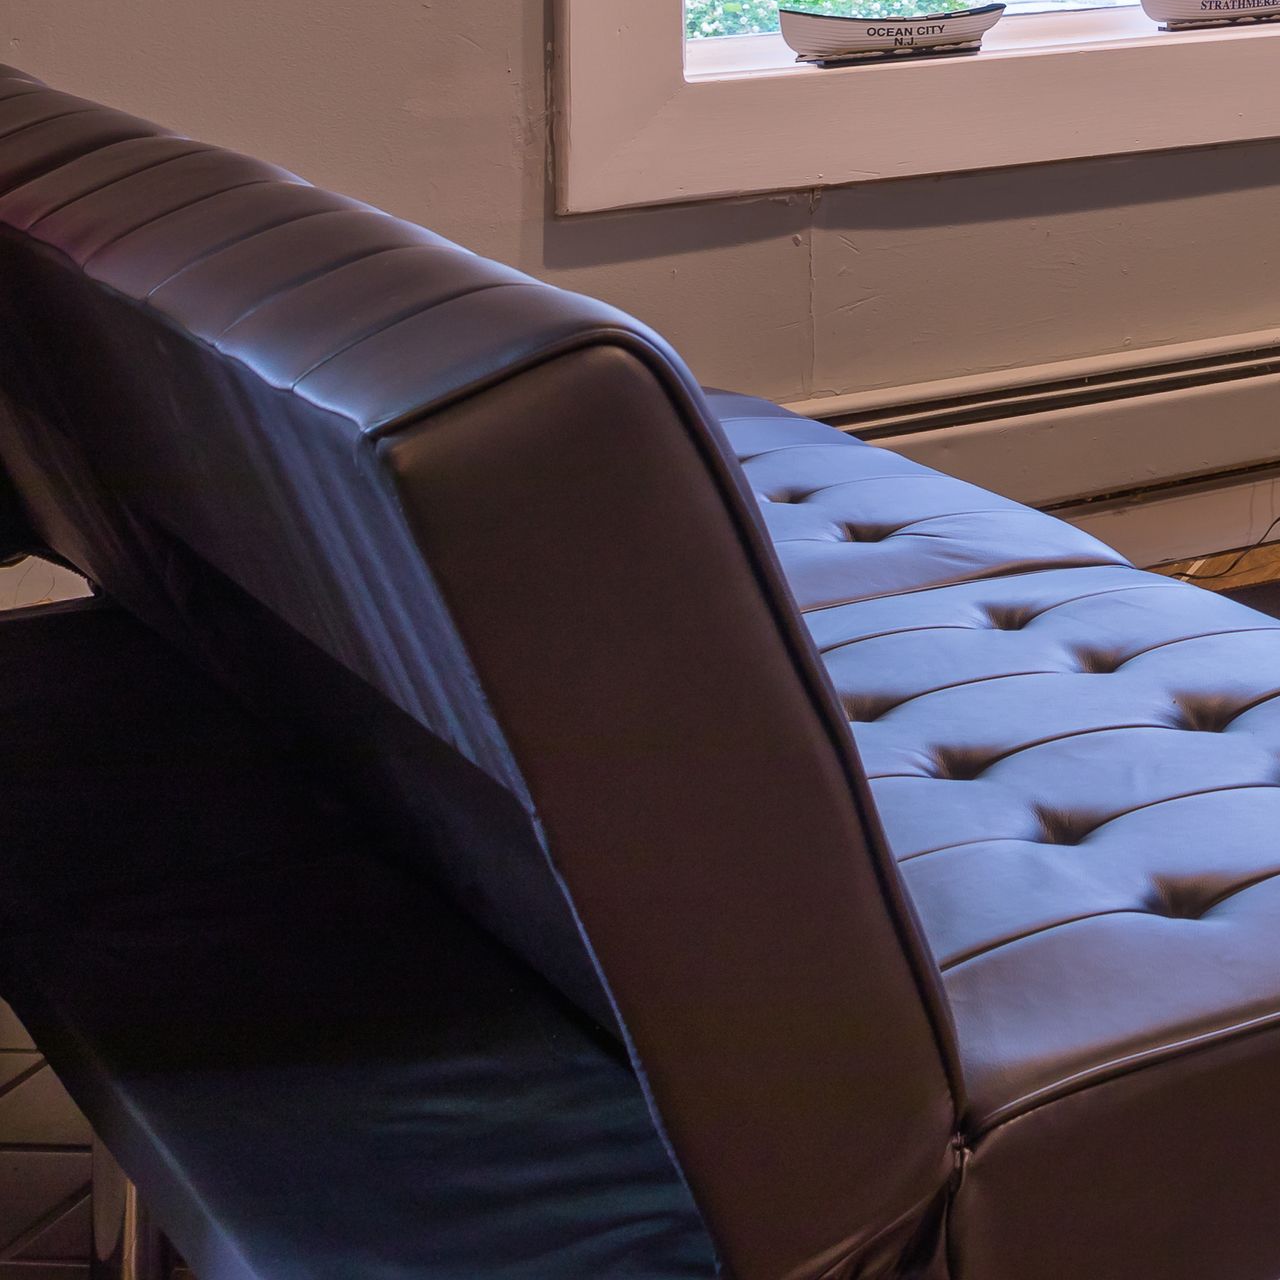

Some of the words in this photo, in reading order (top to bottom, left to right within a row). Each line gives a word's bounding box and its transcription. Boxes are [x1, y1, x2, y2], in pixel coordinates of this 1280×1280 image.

[866, 26, 913, 37] OCEAN
[916, 24, 945, 36] CITY
[894, 37, 918, 46] N.J.
